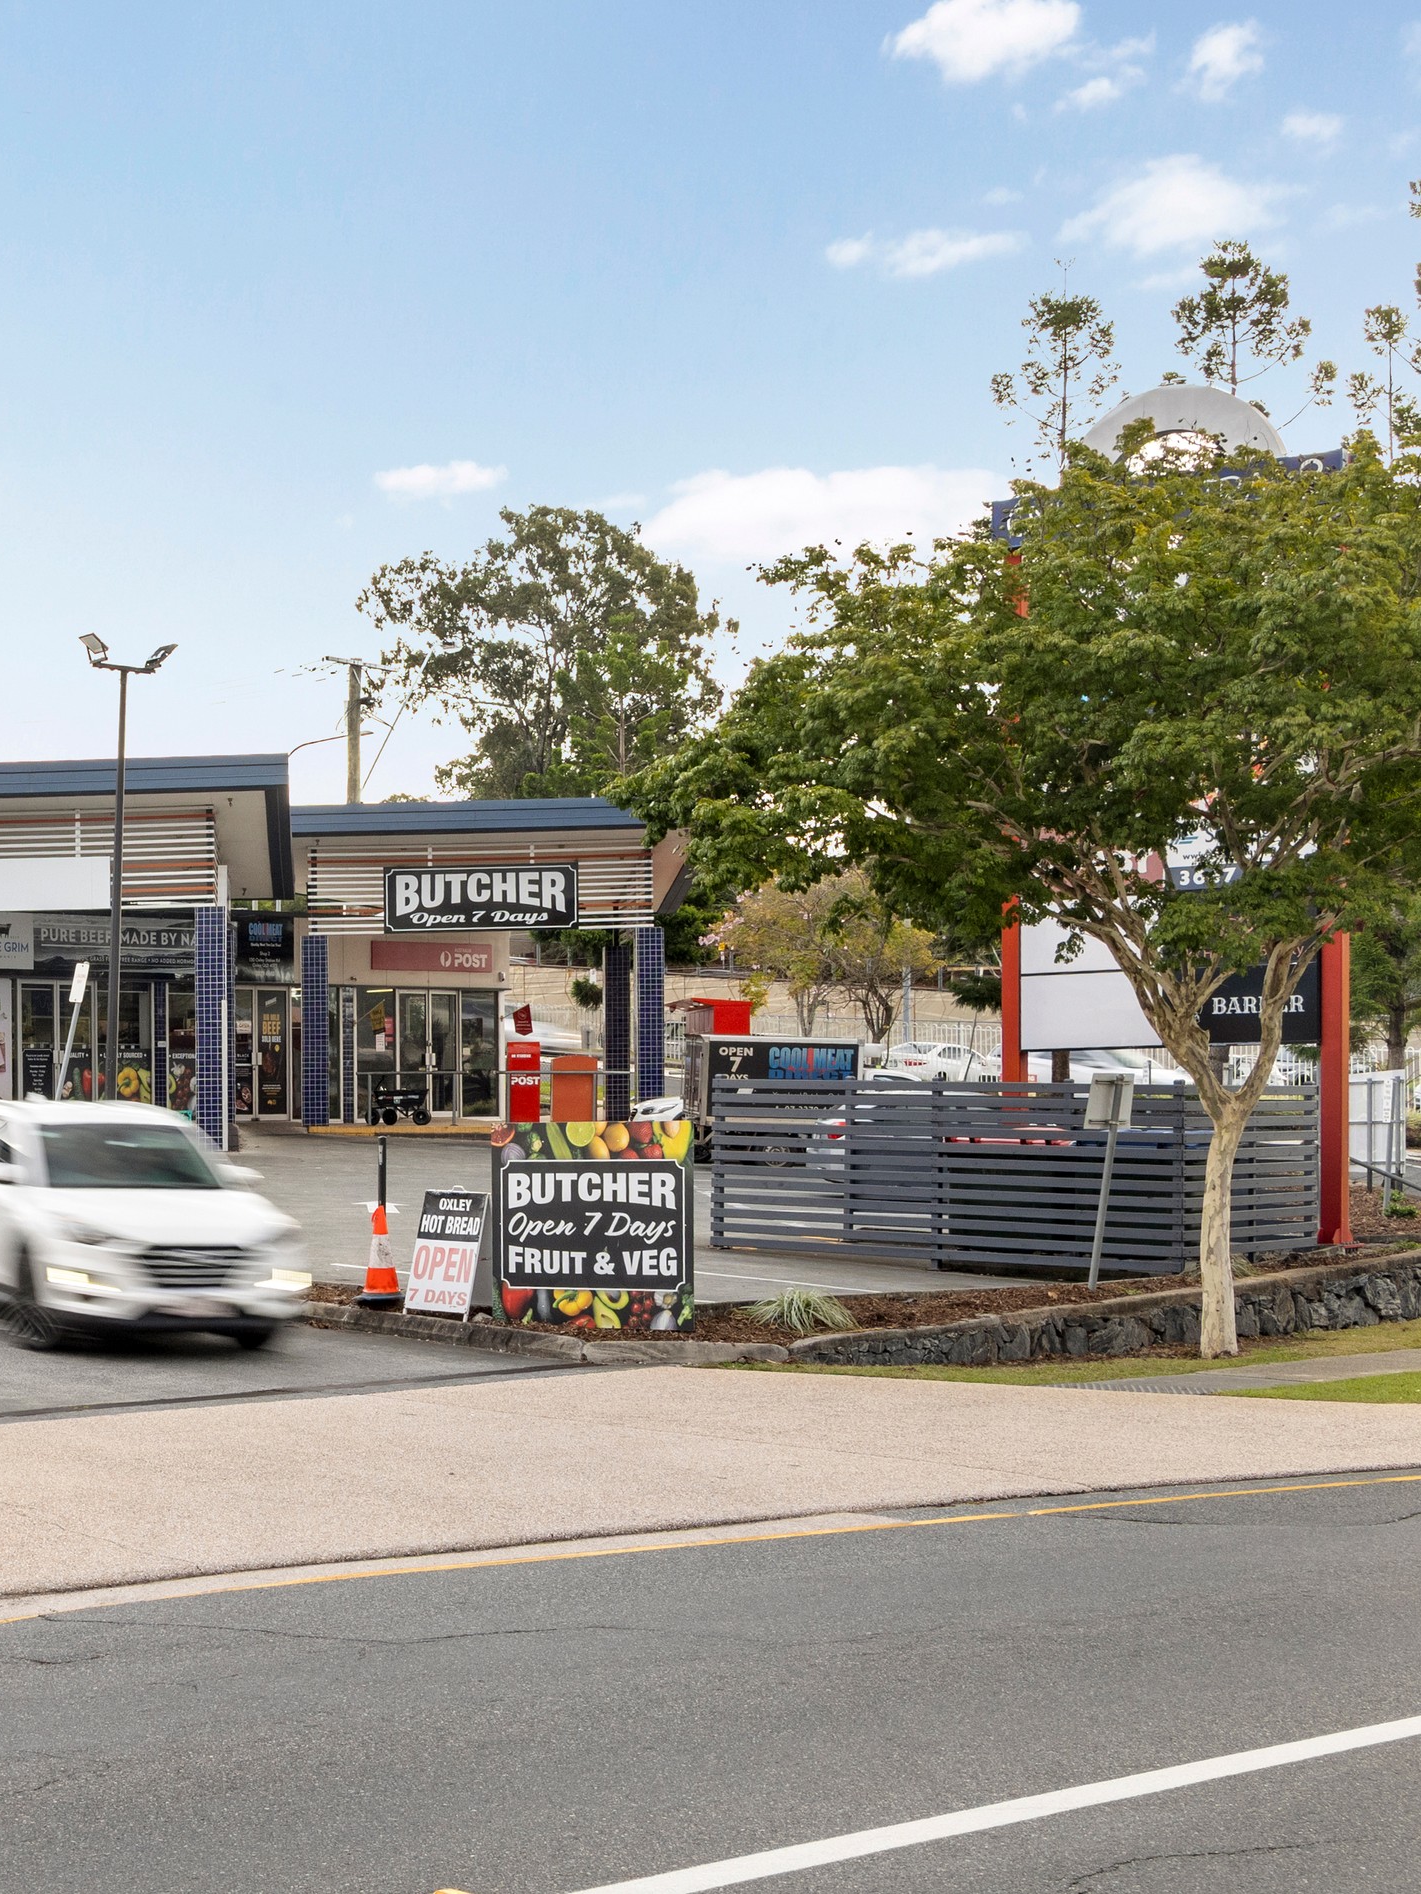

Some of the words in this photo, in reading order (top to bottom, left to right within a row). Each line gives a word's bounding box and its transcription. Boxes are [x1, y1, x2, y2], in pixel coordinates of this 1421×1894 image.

[395, 871, 567, 917] BUTCHER
[409, 912, 467, 927] Open
[472, 911, 486, 923] 7
[490, 910, 548, 925] Days
[41, 928, 76, 943] PURE
[80, 930, 112, 944] BEEF
[120, 931, 157, 945] MADE
[161, 933, 178, 945] BY
[4, 942, 29, 952] GRIM
[454, 953, 488, 968] POST
[1211, 994, 1305, 1015] BARR
[262, 1021, 280, 1034] BEEF
[719, 1047, 754, 1057] OPEN
[768, 1047, 808, 1069] COOL
[813, 1047, 854, 1071] MEAT
[729, 1057, 743, 1073] 7
[511, 1077, 540, 1085] POST
[508, 1172, 677, 1209] BUTCHER
[439, 1198, 472, 1211] OXLEY
[420, 1214, 445, 1234] HOT
[445, 1216, 480, 1235] BREAD
[508, 1212, 576, 1243] Open
[583, 1212, 603, 1236] 7
[604, 1212, 677, 1245] Days
[413, 1245, 474, 1283] OPEN
[508, 1245, 587, 1274] FRUIT
[593, 1251, 615, 1275] &
[622, 1247, 678, 1277] VEG
[409, 1288, 419, 1302] 7
[424, 1289, 468, 1306] DAYS
